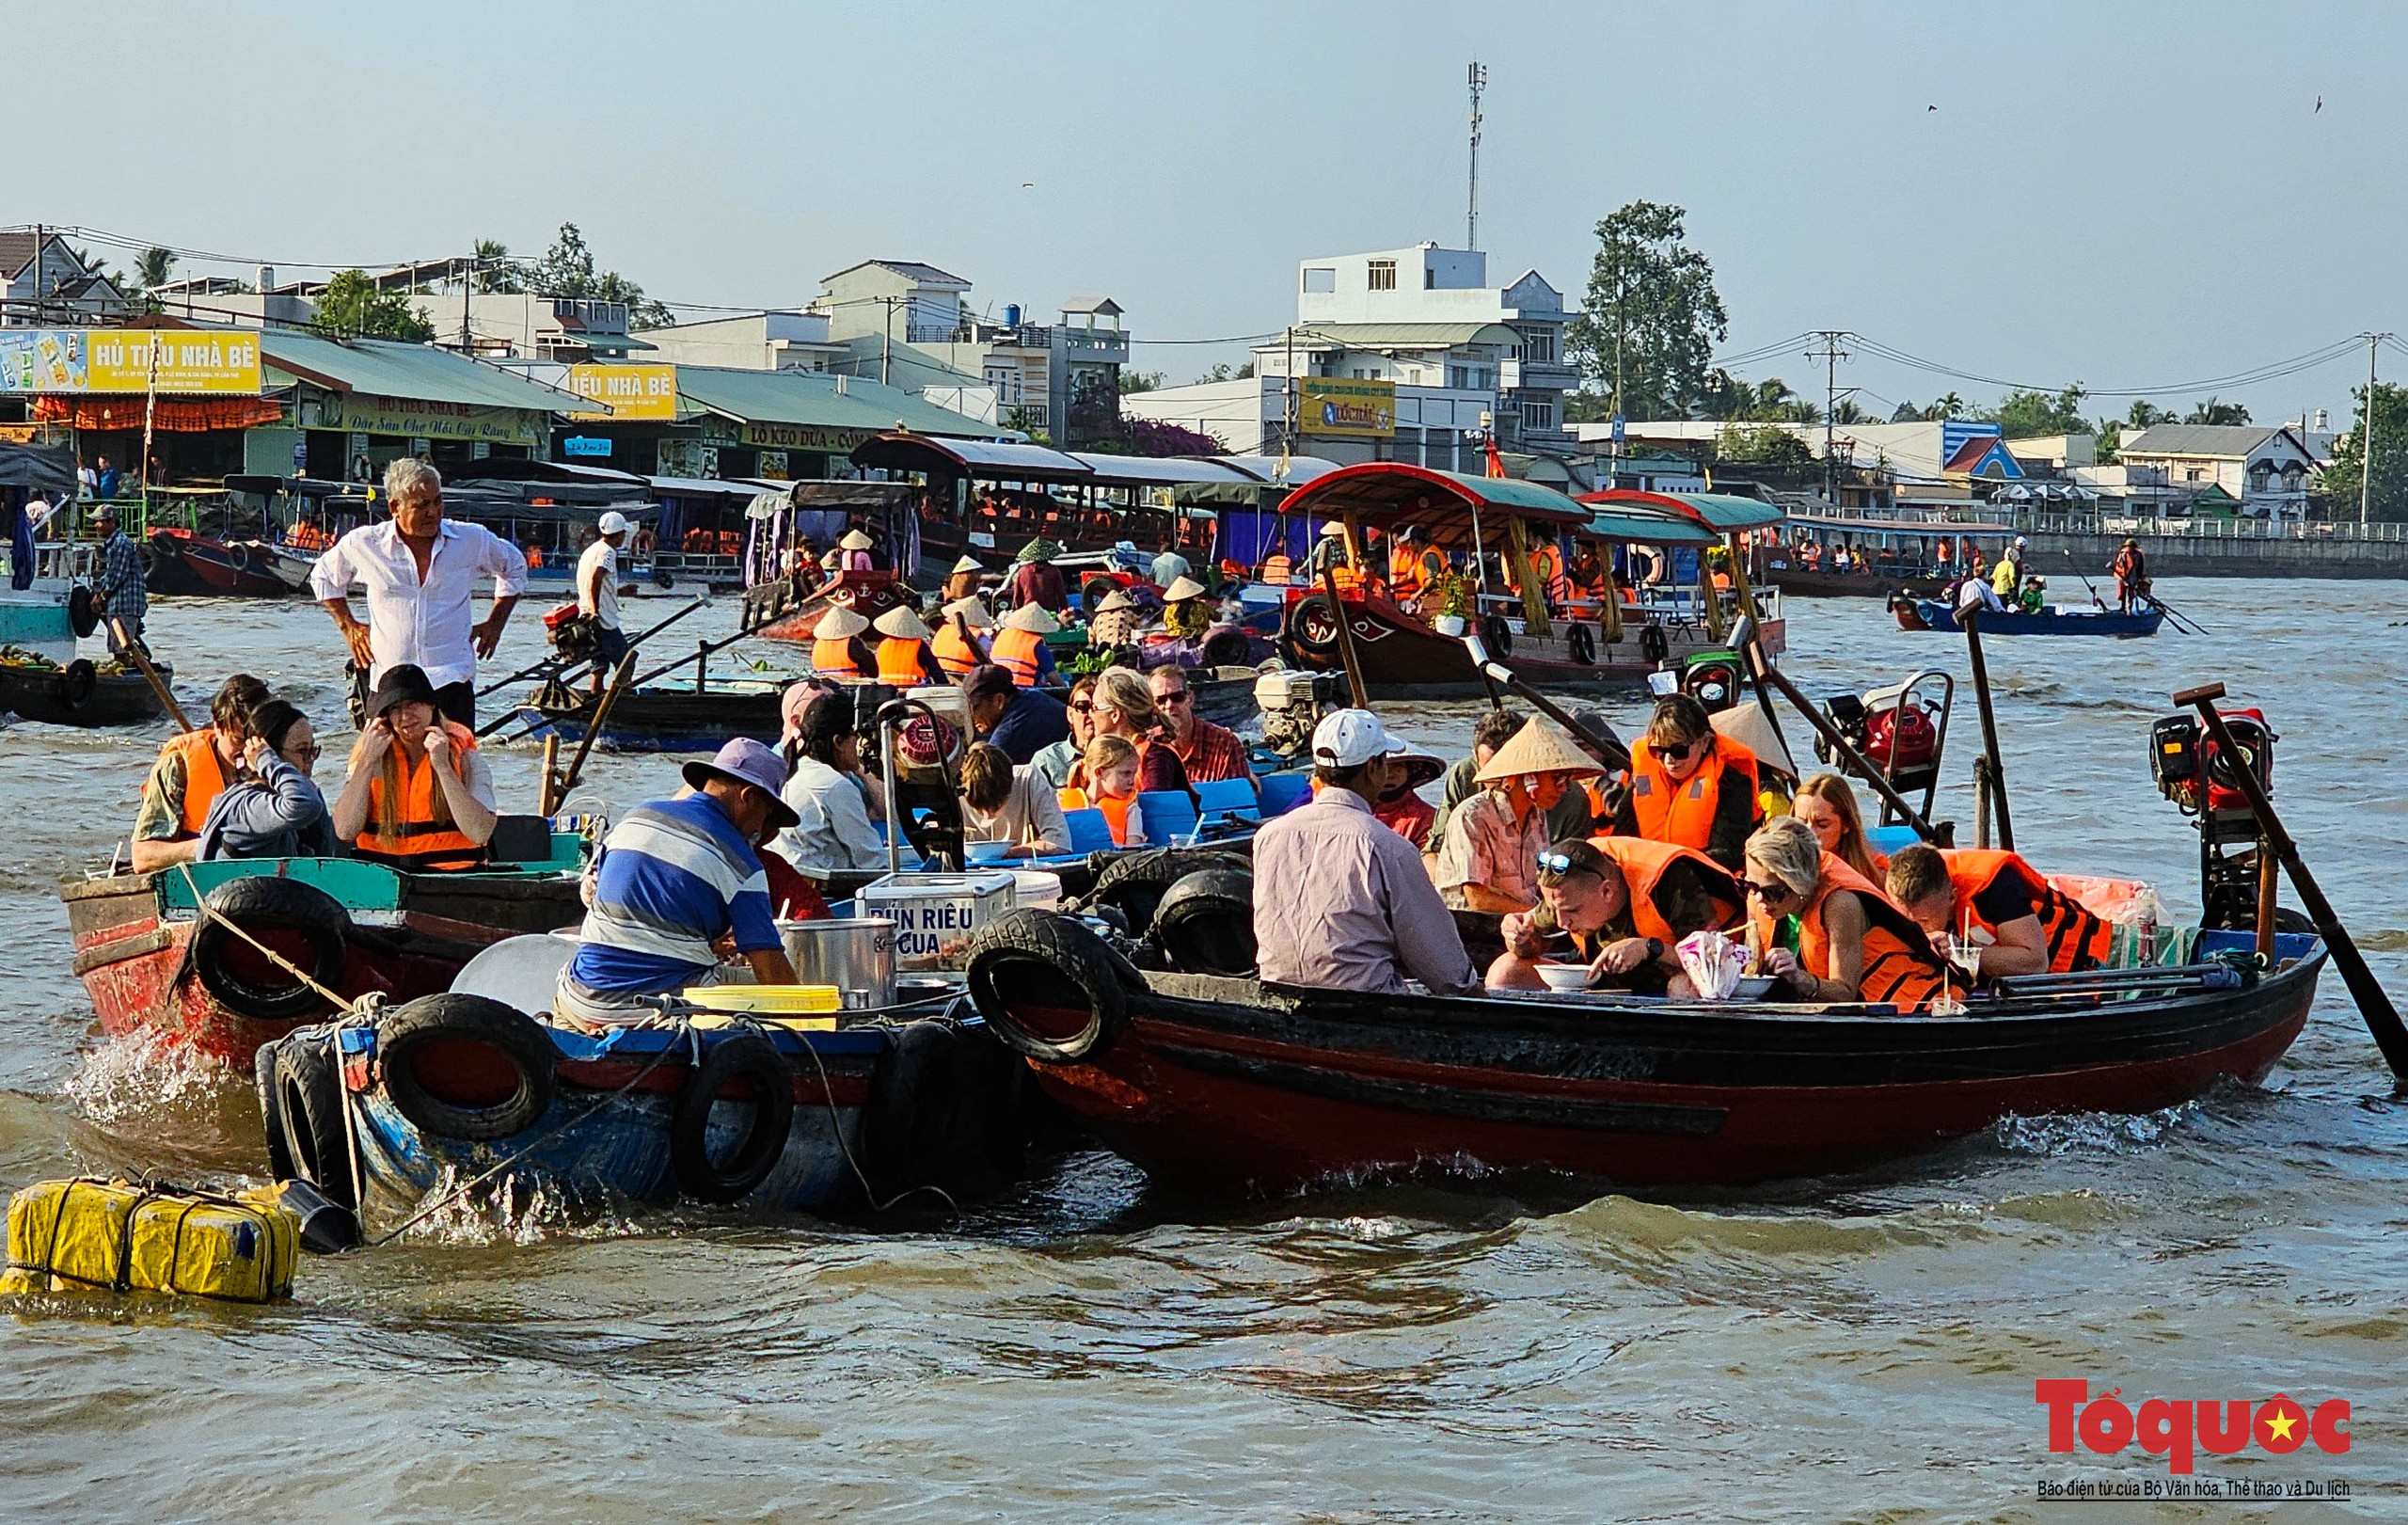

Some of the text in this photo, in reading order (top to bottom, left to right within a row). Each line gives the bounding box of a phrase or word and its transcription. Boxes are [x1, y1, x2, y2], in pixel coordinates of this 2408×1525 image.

[96, 339, 125, 367] HỦ
[182, 340, 223, 368] NHÀ
[229, 341, 254, 368] BÈ
[607, 373, 643, 396] NHÀ
[648, 373, 671, 396] BÈ
[1614, 420, 1623, 436] P
[923, 902, 973, 929] RIÊU
[897, 932, 940, 954] CUA
